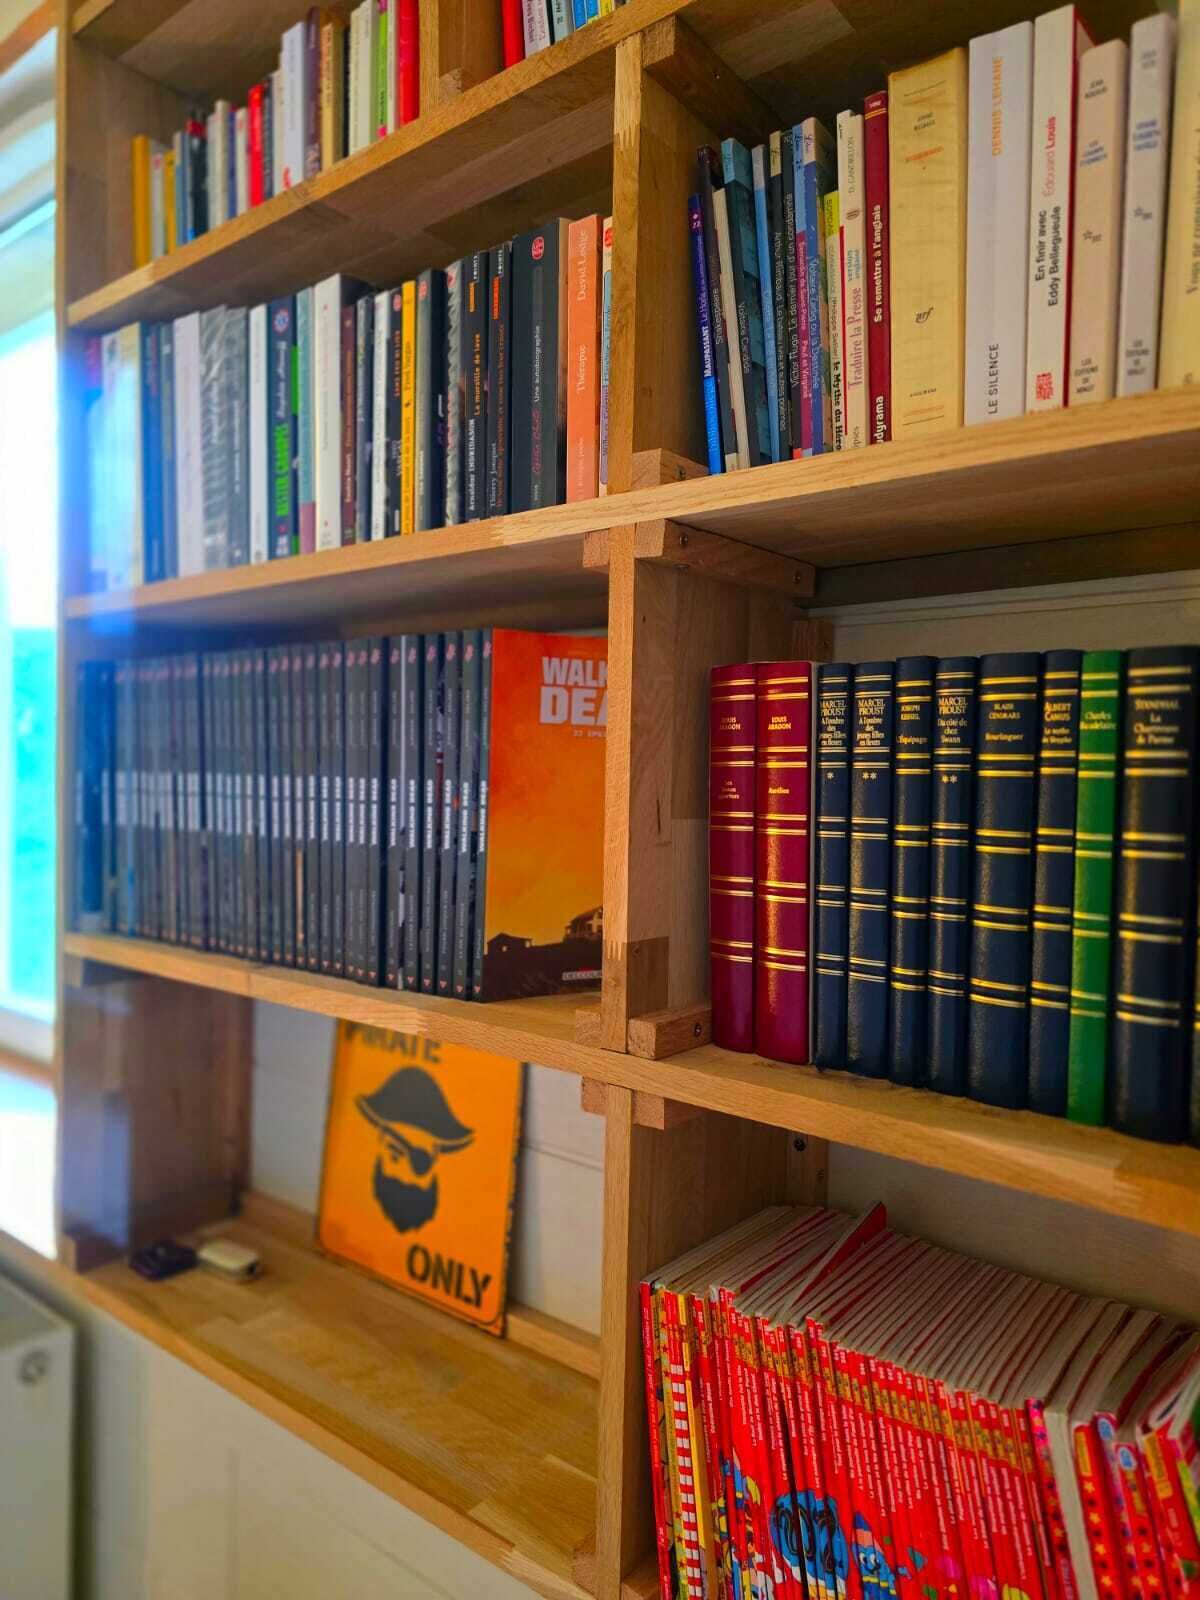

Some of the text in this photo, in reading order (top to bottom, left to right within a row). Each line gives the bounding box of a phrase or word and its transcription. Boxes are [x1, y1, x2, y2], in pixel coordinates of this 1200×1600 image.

[991, 109, 1002, 156] DENNIS
[1045, 117, 1056, 149] Louis
[871, 204, 883, 249] l'anglais
[775, 232, 783, 260] Arthur
[786, 241, 795, 261] d'un
[1035, 210, 1047, 280] En finir avec
[1048, 206, 1062, 306] Eddy Bellegueule
[577, 229, 589, 300] David Lodge
[787, 264, 797, 282] jour
[873, 259, 882, 305] remettre
[712, 287, 723, 345] Shakespeare
[874, 308, 883, 322] Se
[914, 306, 934, 324] nrf
[737, 301, 750, 374] Voltaire Candide
[847, 287, 864, 389] Traduire la Presse
[474, 355, 480, 364] de
[534, 326, 543, 384] autobiographie
[702, 325, 712, 377] MAUPASSANT
[789, 334, 800, 388] Victor Hugo
[988, 344, 999, 414] LE SILENCE
[474, 403, 480, 416] La
[832, 361, 843, 450] le Mythe du Héro
[542, 656, 608, 687] WALK
[821, 700, 847, 708] MARCEL
[858, 699, 886, 707] MARCEL
[858, 707, 884, 715] PROUST
[938, 697, 968, 706] MARCEL
[938, 705, 966, 715] PROUST
[1044, 702, 1072, 712] ALBERT
[1134, 700, 1179, 711] STENDHAL
[767, 723, 791, 731] ARAGON
[1044, 711, 1071, 721] CAMUS
[1079, 721, 1116, 730] Baudelaire
[1085, 711, 1111, 720] Charles
[1150, 714, 1161, 723] La
[872, 730, 884, 738] filles
[941, 736, 961, 744] Swann
[1133, 724, 1179, 734] Chartreuse
[1136, 735, 1175, 744] de Parme
[371, 778, 379, 801] DEAD
[390, 779, 398, 802] DEAD
[408, 779, 416, 848] WALKING DEAD
[426, 779, 434, 849] WALKING DEAD
[444, 779, 453, 849] WALKING DEAD
[461, 782, 470, 853] WALKING DEAD
[478, 780, 487, 852] WALKING DEAD
[406, 1243, 491, 1308] ONLY
